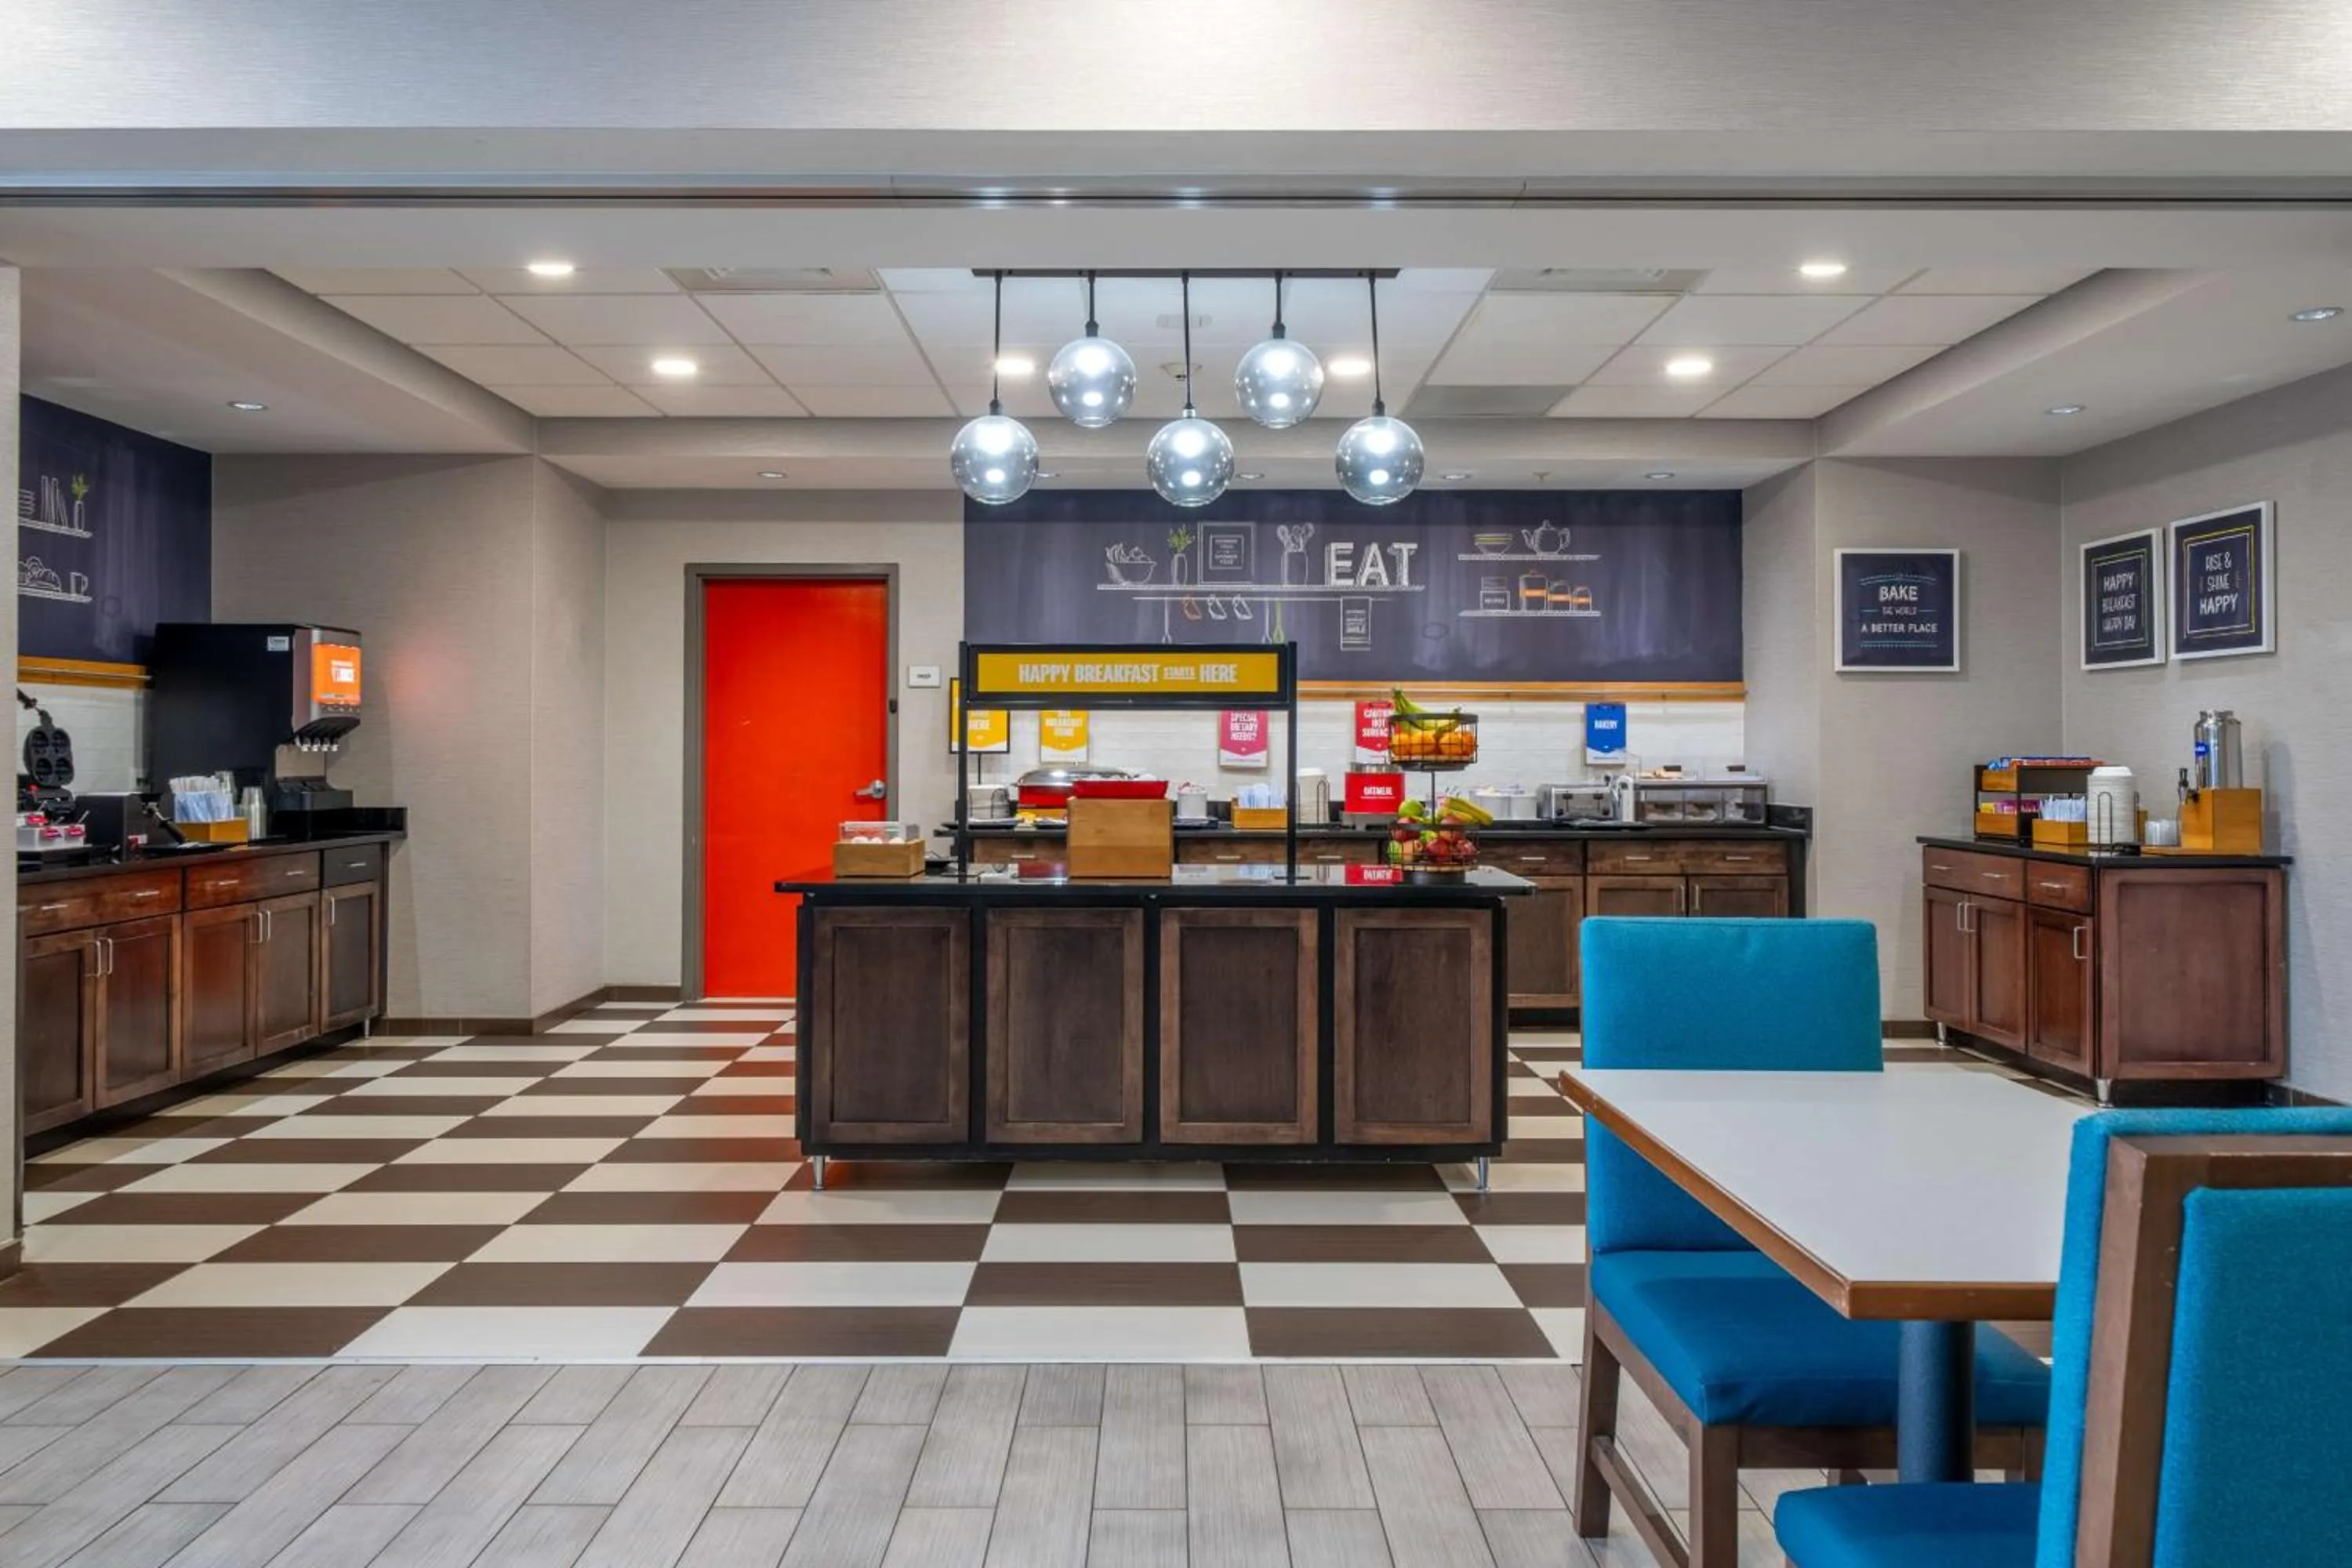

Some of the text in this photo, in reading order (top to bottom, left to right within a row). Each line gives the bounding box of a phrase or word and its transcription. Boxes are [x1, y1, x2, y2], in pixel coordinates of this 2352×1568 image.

[1325, 542, 1418, 586] EAT
[2205, 551, 2232, 572] RISE &
[2103, 572, 2135, 593] HAPPY
[2208, 573, 2230, 592] SHINE
[1878, 585, 1919, 602] BAKE
[1882, 606, 1918, 615] THE WORLD
[2102, 593, 2137, 614] BREAKFAST
[2199, 592, 2238, 615] HAPPY
[1860, 623, 1938, 633] A BETTER PLACE
[2124, 614, 2136, 630] DAY
[1019, 664, 1069, 683] HAPPY
[1074, 664, 1160, 683] BREAKFAST
[1200, 664, 1238, 683] HERE
[1230, 721, 1258, 731] DIETARY
[1371, 719, 1385, 728] HOT
[1594, 719, 1618, 730] BAKERY
[1230, 731, 1257, 741] NEEDS?
[1362, 728, 1388, 737] SURFAC
[1363, 786, 1393, 796] OATMEAL
